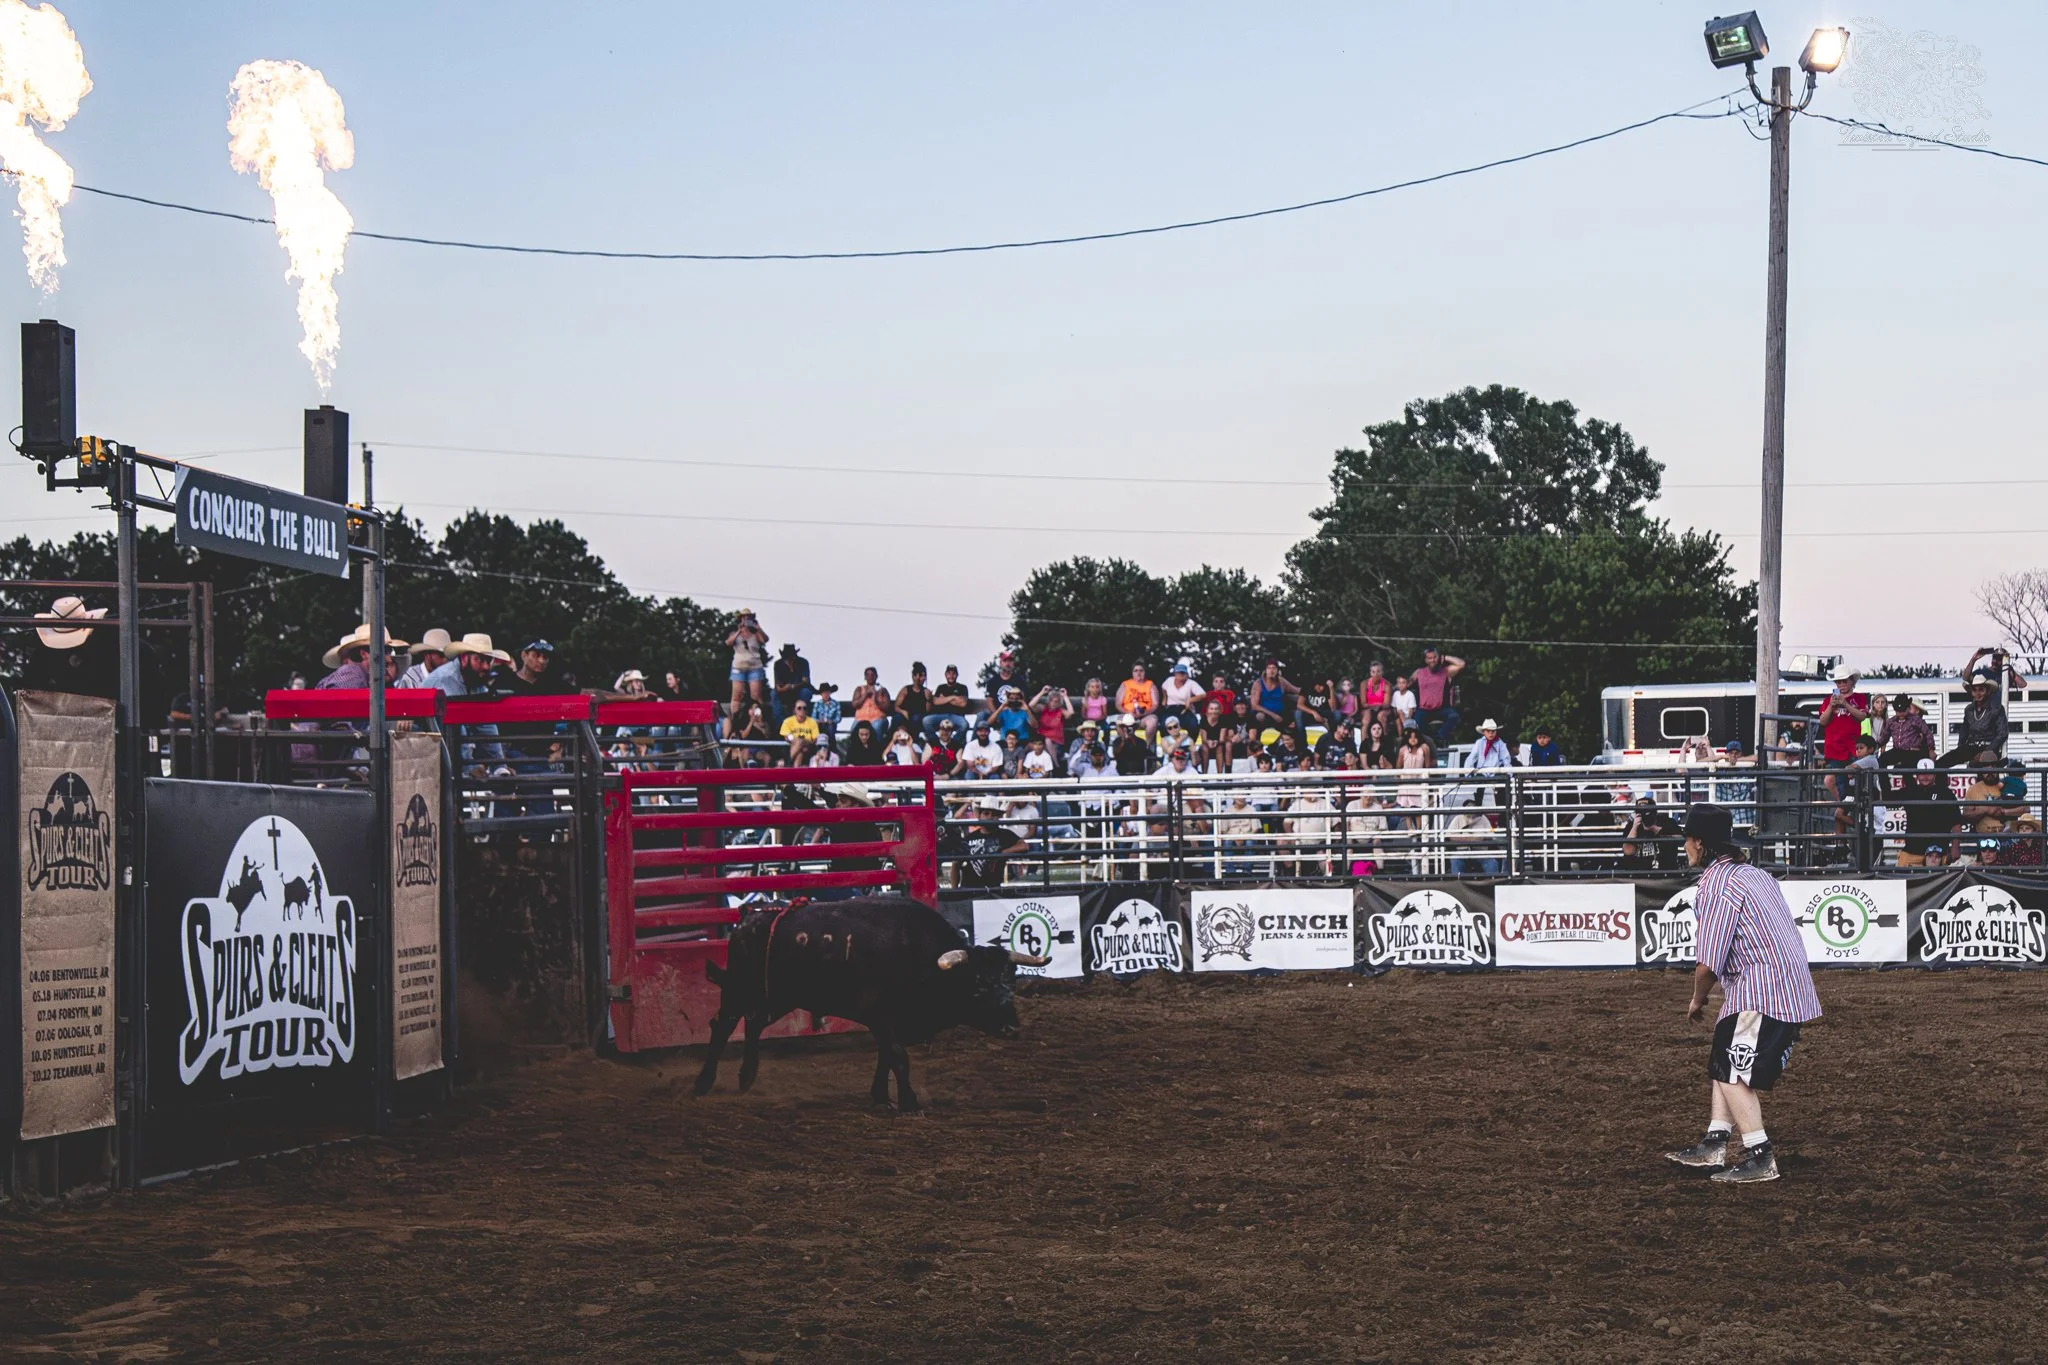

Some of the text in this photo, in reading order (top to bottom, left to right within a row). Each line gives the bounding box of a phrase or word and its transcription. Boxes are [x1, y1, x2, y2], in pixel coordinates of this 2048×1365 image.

[189, 486, 340, 560] CONQUER THE BULL
[30, 809, 109, 884] SPURS & CLEATS
[46, 866, 98, 886] TOUR
[1805, 885, 1878, 914] BIG COUNTRY
[1002, 902, 1059, 934] BIG COUNTRY
[1258, 915, 1348, 930] CINCH
[1500, 909, 1631, 942] CAVENDER'S
[1261, 932, 1293, 941] JEANS
[1372, 915, 1487, 960] SPURS & CLEATS
[1526, 932, 1542, 941] DON'T
[1545, 931, 1558, 939] JUST
[1561, 930, 1577, 939] WEAR
[1644, 912, 1691, 957] SPURS
[1924, 911, 2042, 957] SPURS & CLEATS
[1093, 926, 1130, 969] SPURS
[1132, 934, 1141, 953] &
[1211, 945, 1241, 953] CINCH
[1394, 949, 1466, 960] TOUR
[1667, 946, 1696, 958] TO
[1826, 947, 1860, 958] TOYS
[1947, 945, 2023, 958] TOUR
[1111, 957, 1169, 972] TOUR
[53, 987, 96, 1001] HUNTSVILLE,
[185, 900, 353, 1068] SPURS & CLEATS
[53, 1044, 96, 1060] HUNTSVILLE,
[223, 1017, 331, 1068] TOUR
